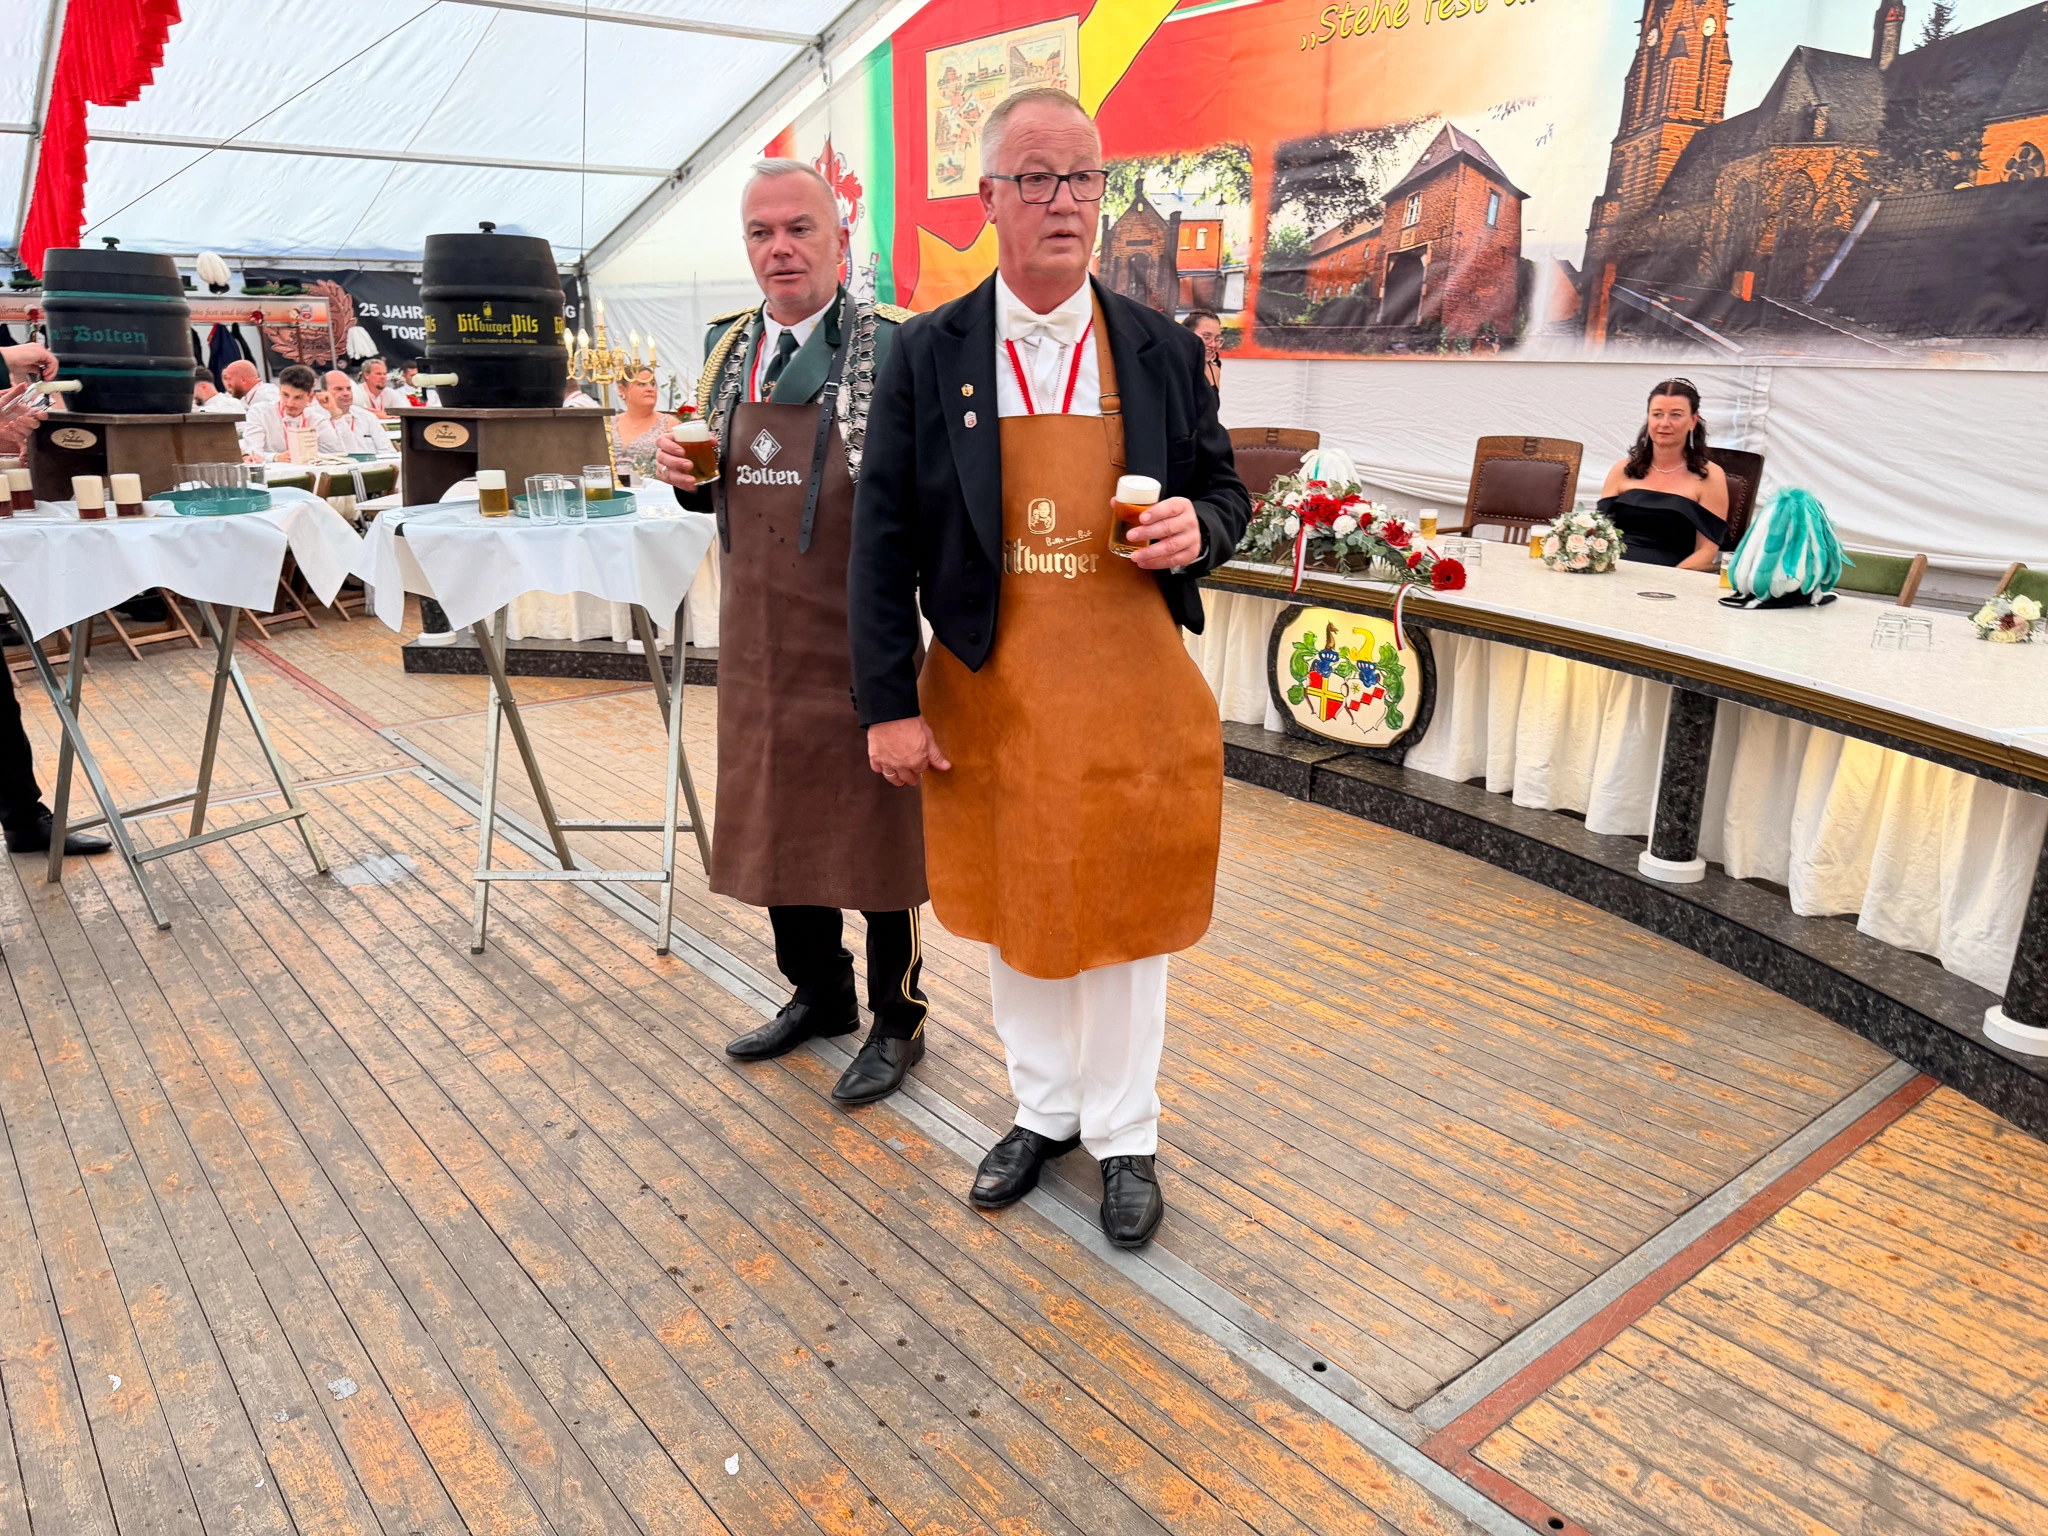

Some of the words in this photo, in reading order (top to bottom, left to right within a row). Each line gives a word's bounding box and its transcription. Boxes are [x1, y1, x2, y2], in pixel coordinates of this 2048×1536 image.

[358, 302, 380, 317] 25
[381, 304, 424, 319] JAHR
[73, 325, 148, 344] Bolten
[381, 324, 428, 340] "TORF
[511, 314, 539, 337] Pils
[736, 464, 802, 485] Bolten
[1003, 537, 1100, 580] itburger
